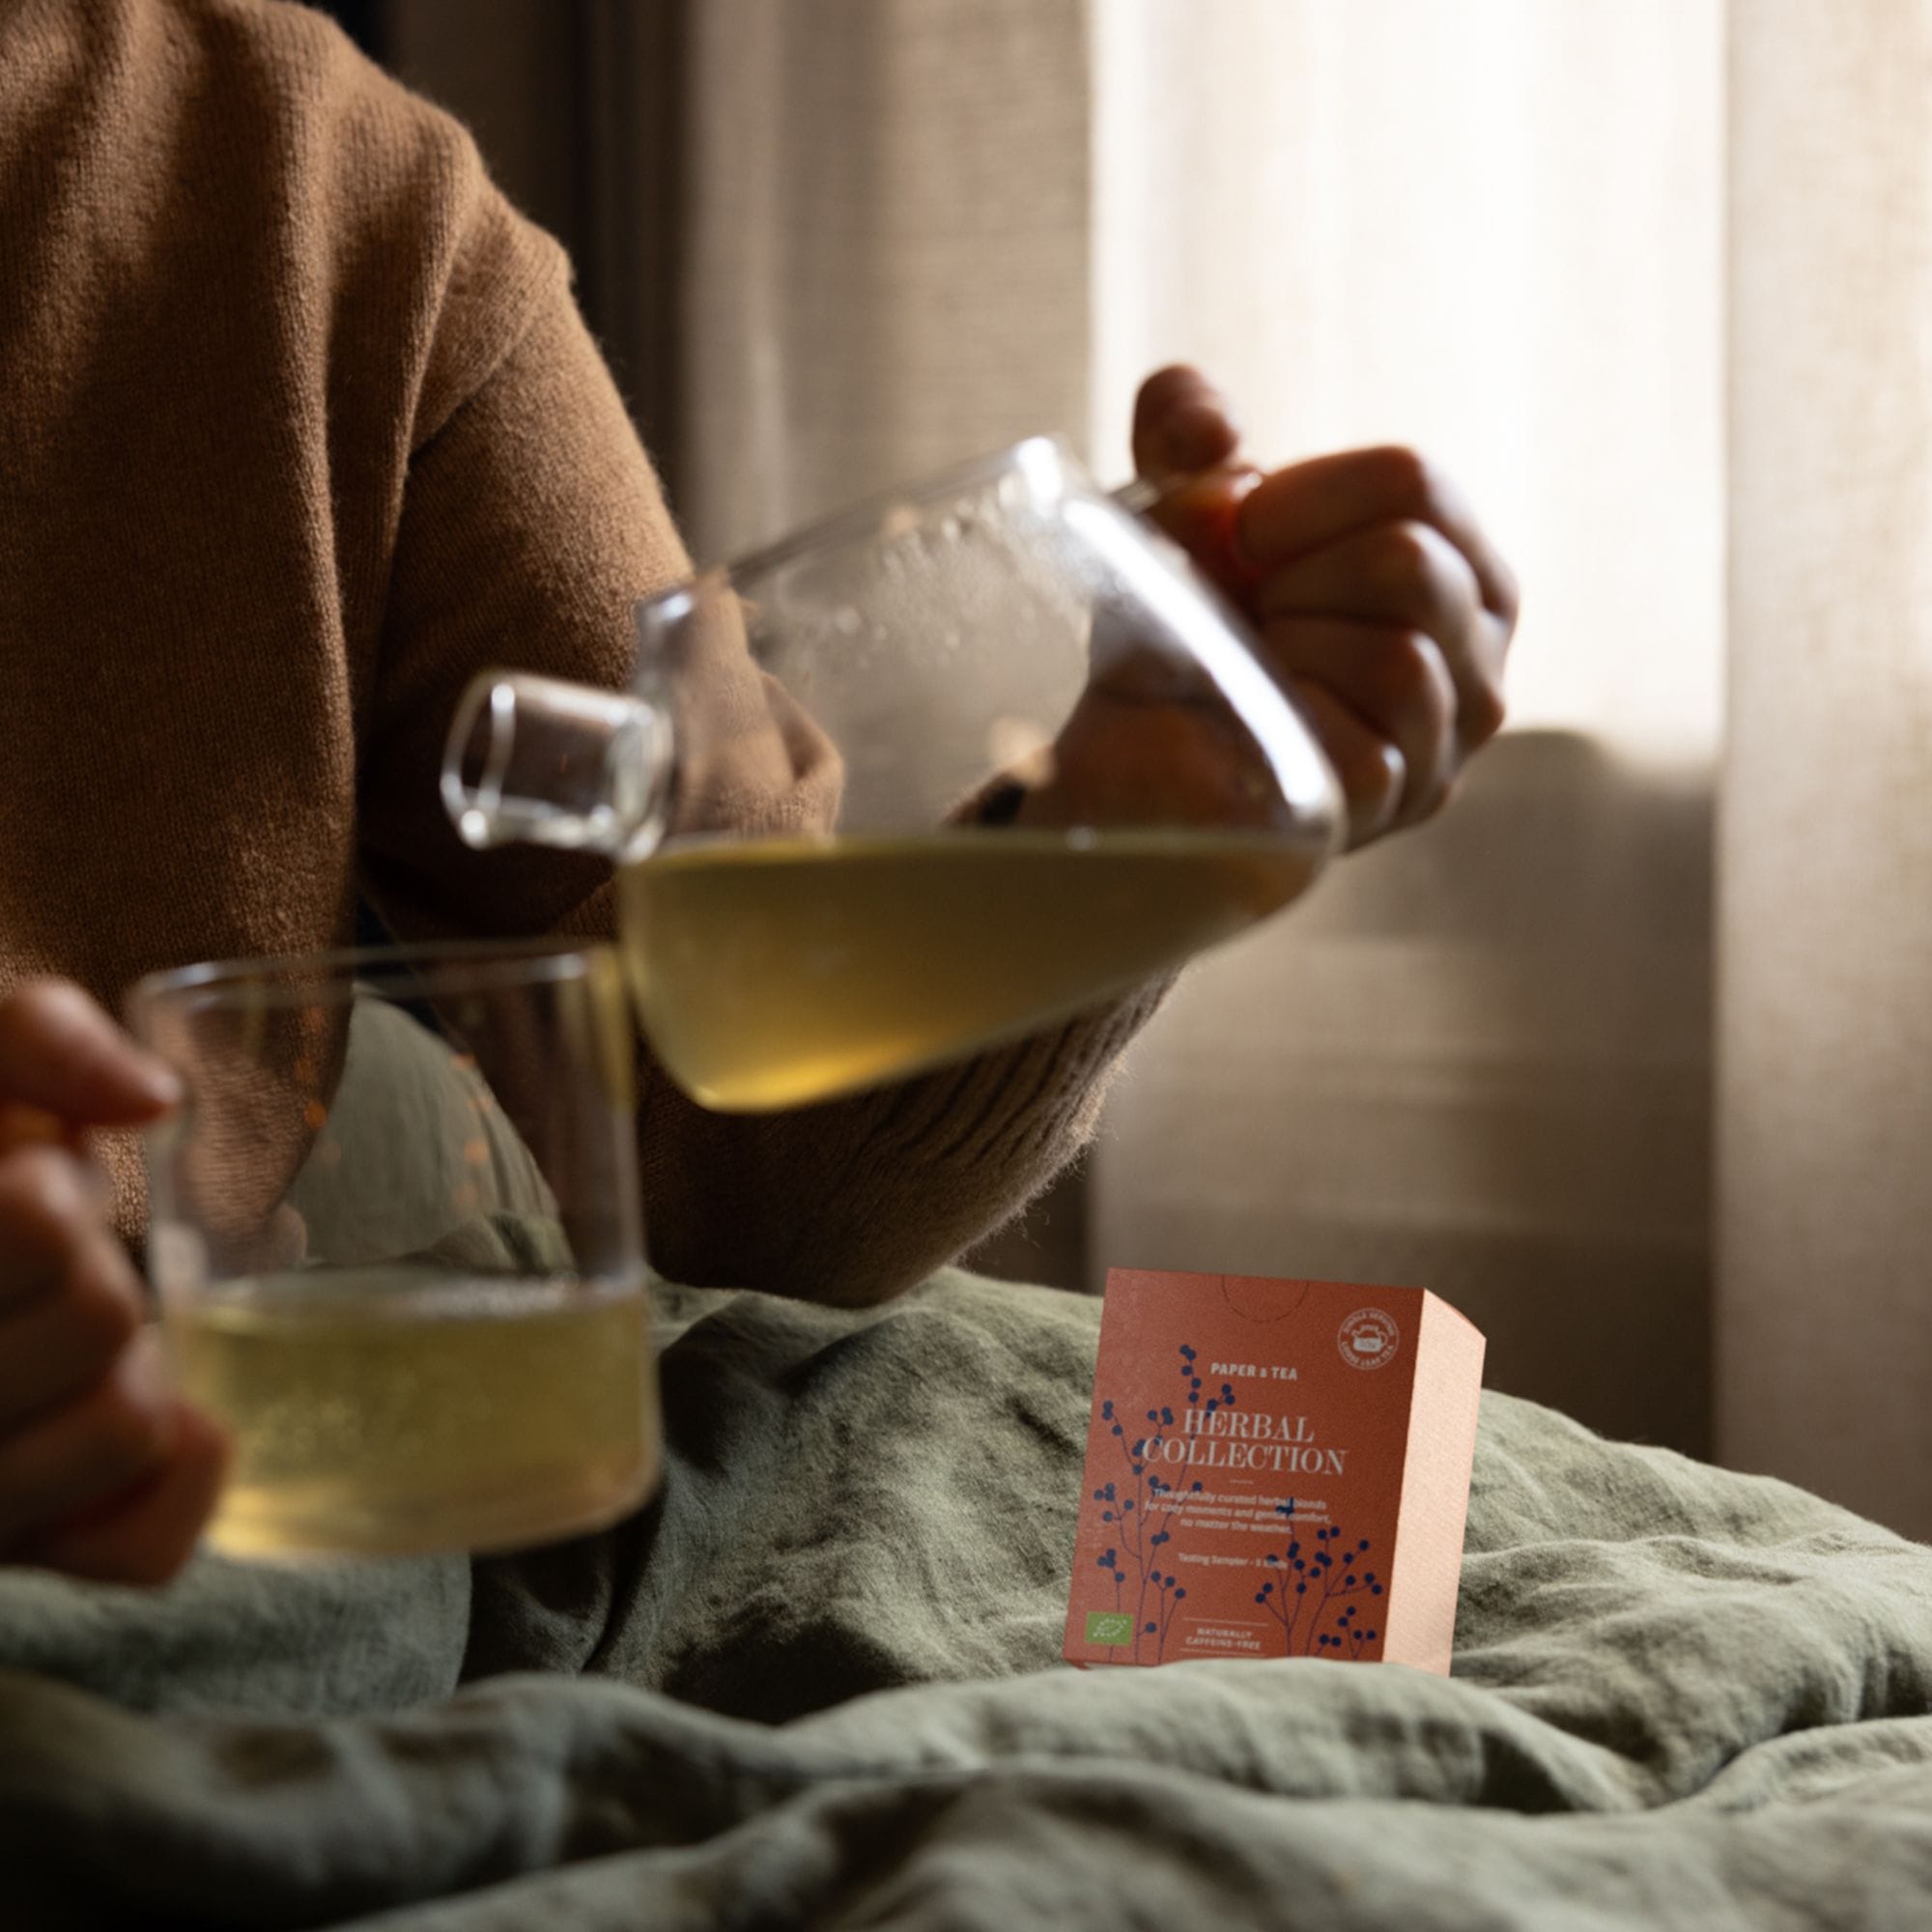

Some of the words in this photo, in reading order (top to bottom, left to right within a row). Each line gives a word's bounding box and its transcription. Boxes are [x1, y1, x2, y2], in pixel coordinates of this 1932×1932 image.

[1210, 1362, 1255, 1378] PAPER
[1271, 1367, 1298, 1380] TEA
[1181, 1408, 1315, 1443] HERBAL
[1142, 1436, 1349, 1475] COLLECTION
[1234, 1508, 1254, 1519] and
[1231, 1520, 1248, 1531] the
